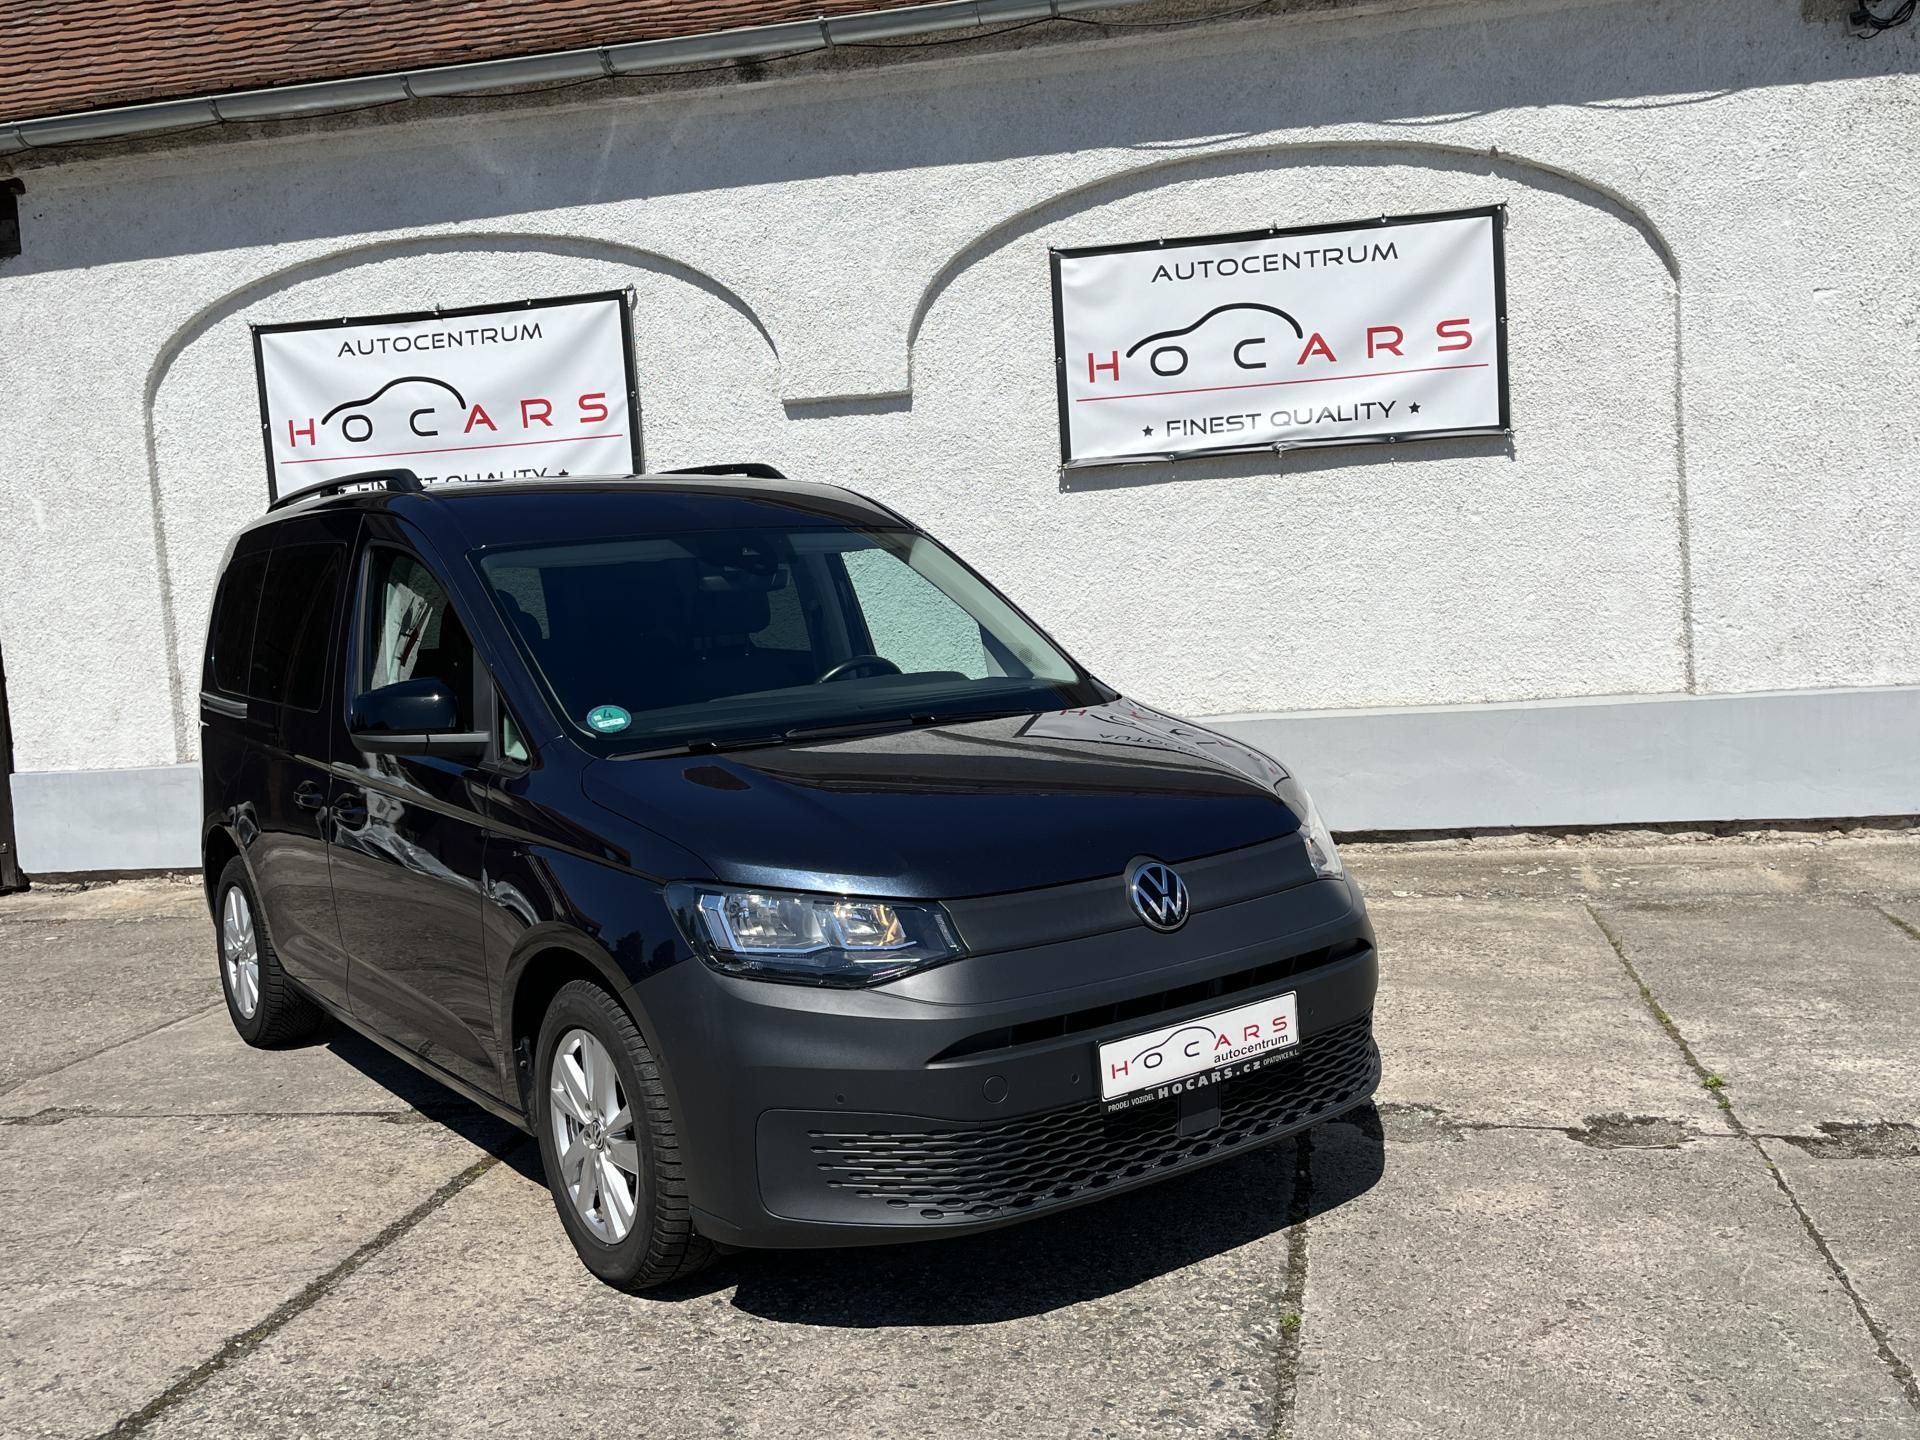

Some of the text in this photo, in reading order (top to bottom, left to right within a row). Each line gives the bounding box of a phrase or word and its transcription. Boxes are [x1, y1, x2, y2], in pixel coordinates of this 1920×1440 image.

[1151, 242, 1398, 283] AUTOCENTRUM
[337, 322, 543, 357] AUTOCENTRUM
[1087, 318, 1473, 383] HOCARS
[288, 392, 608, 447] HOCARS
[1166, 400, 1397, 437] FINEST QUALITY
[1111, 1015, 1288, 1079] HOCARS
[1213, 1034, 1289, 1064] autocentrum
[1108, 1100, 1130, 1112] PRODEJ
[1131, 1093, 1155, 1106] VOZIDEL
